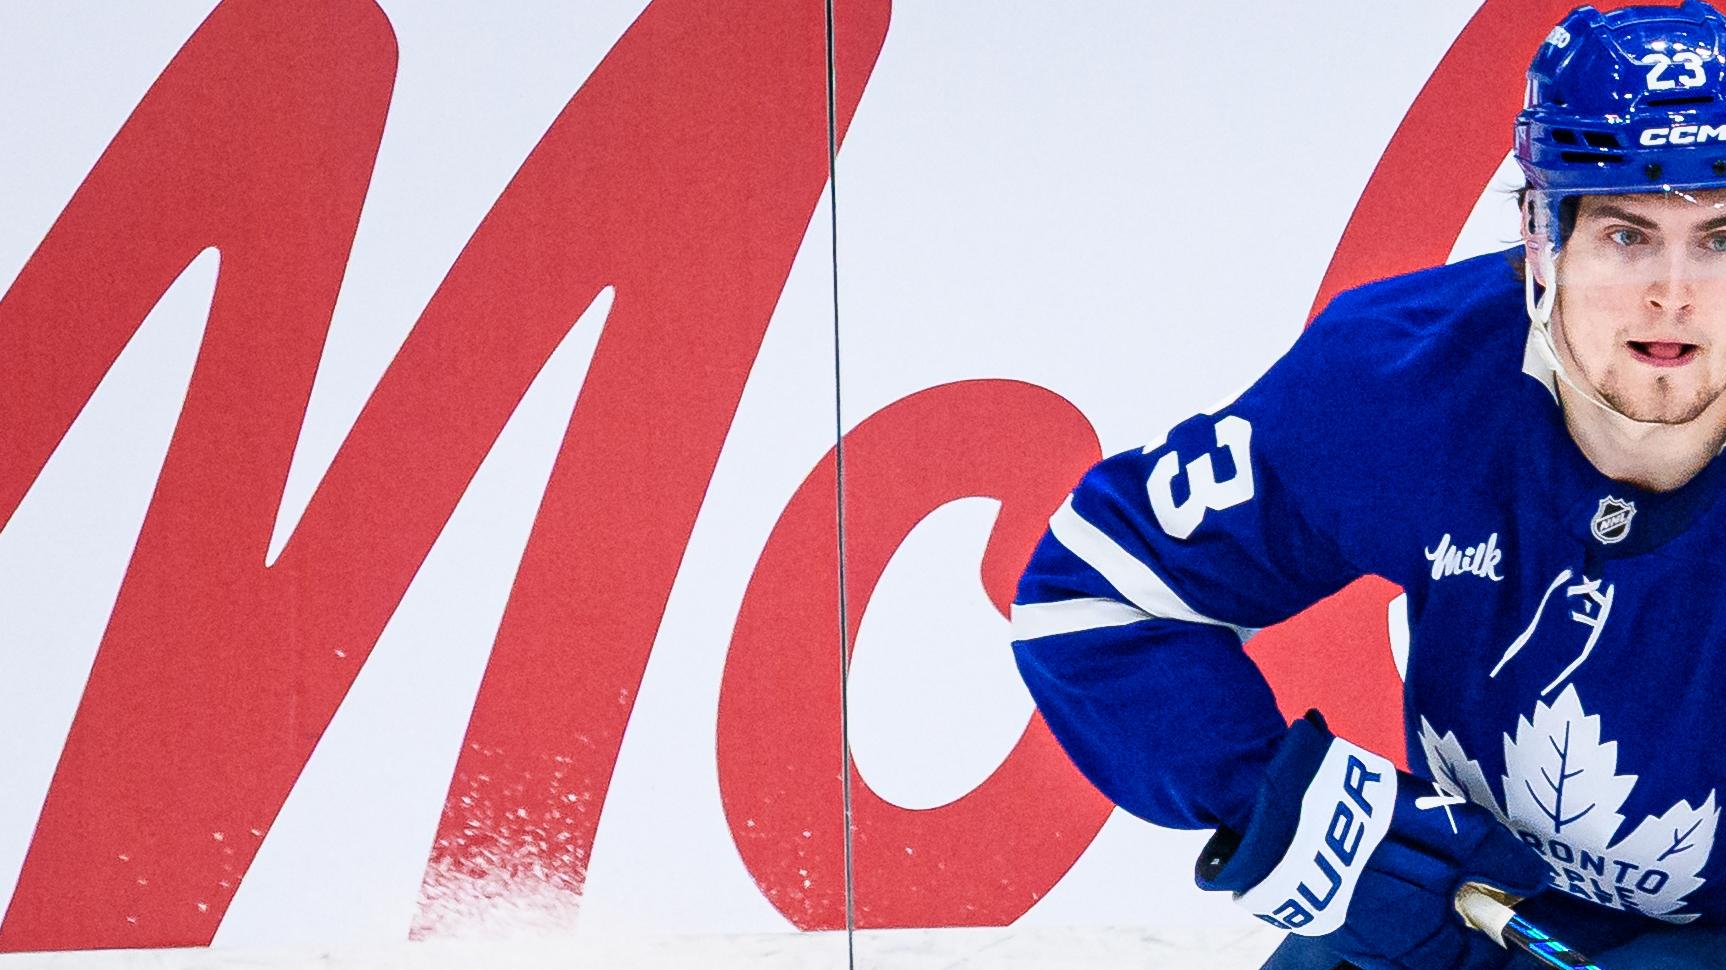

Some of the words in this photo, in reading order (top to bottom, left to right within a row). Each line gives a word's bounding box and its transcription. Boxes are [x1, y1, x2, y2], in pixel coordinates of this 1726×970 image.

[1641, 51, 1707, 90] 23
[1142, 408, 1255, 540] 3
[1424, 532, 1505, 581] Milk
[1517, 829, 1670, 895] RONTO
